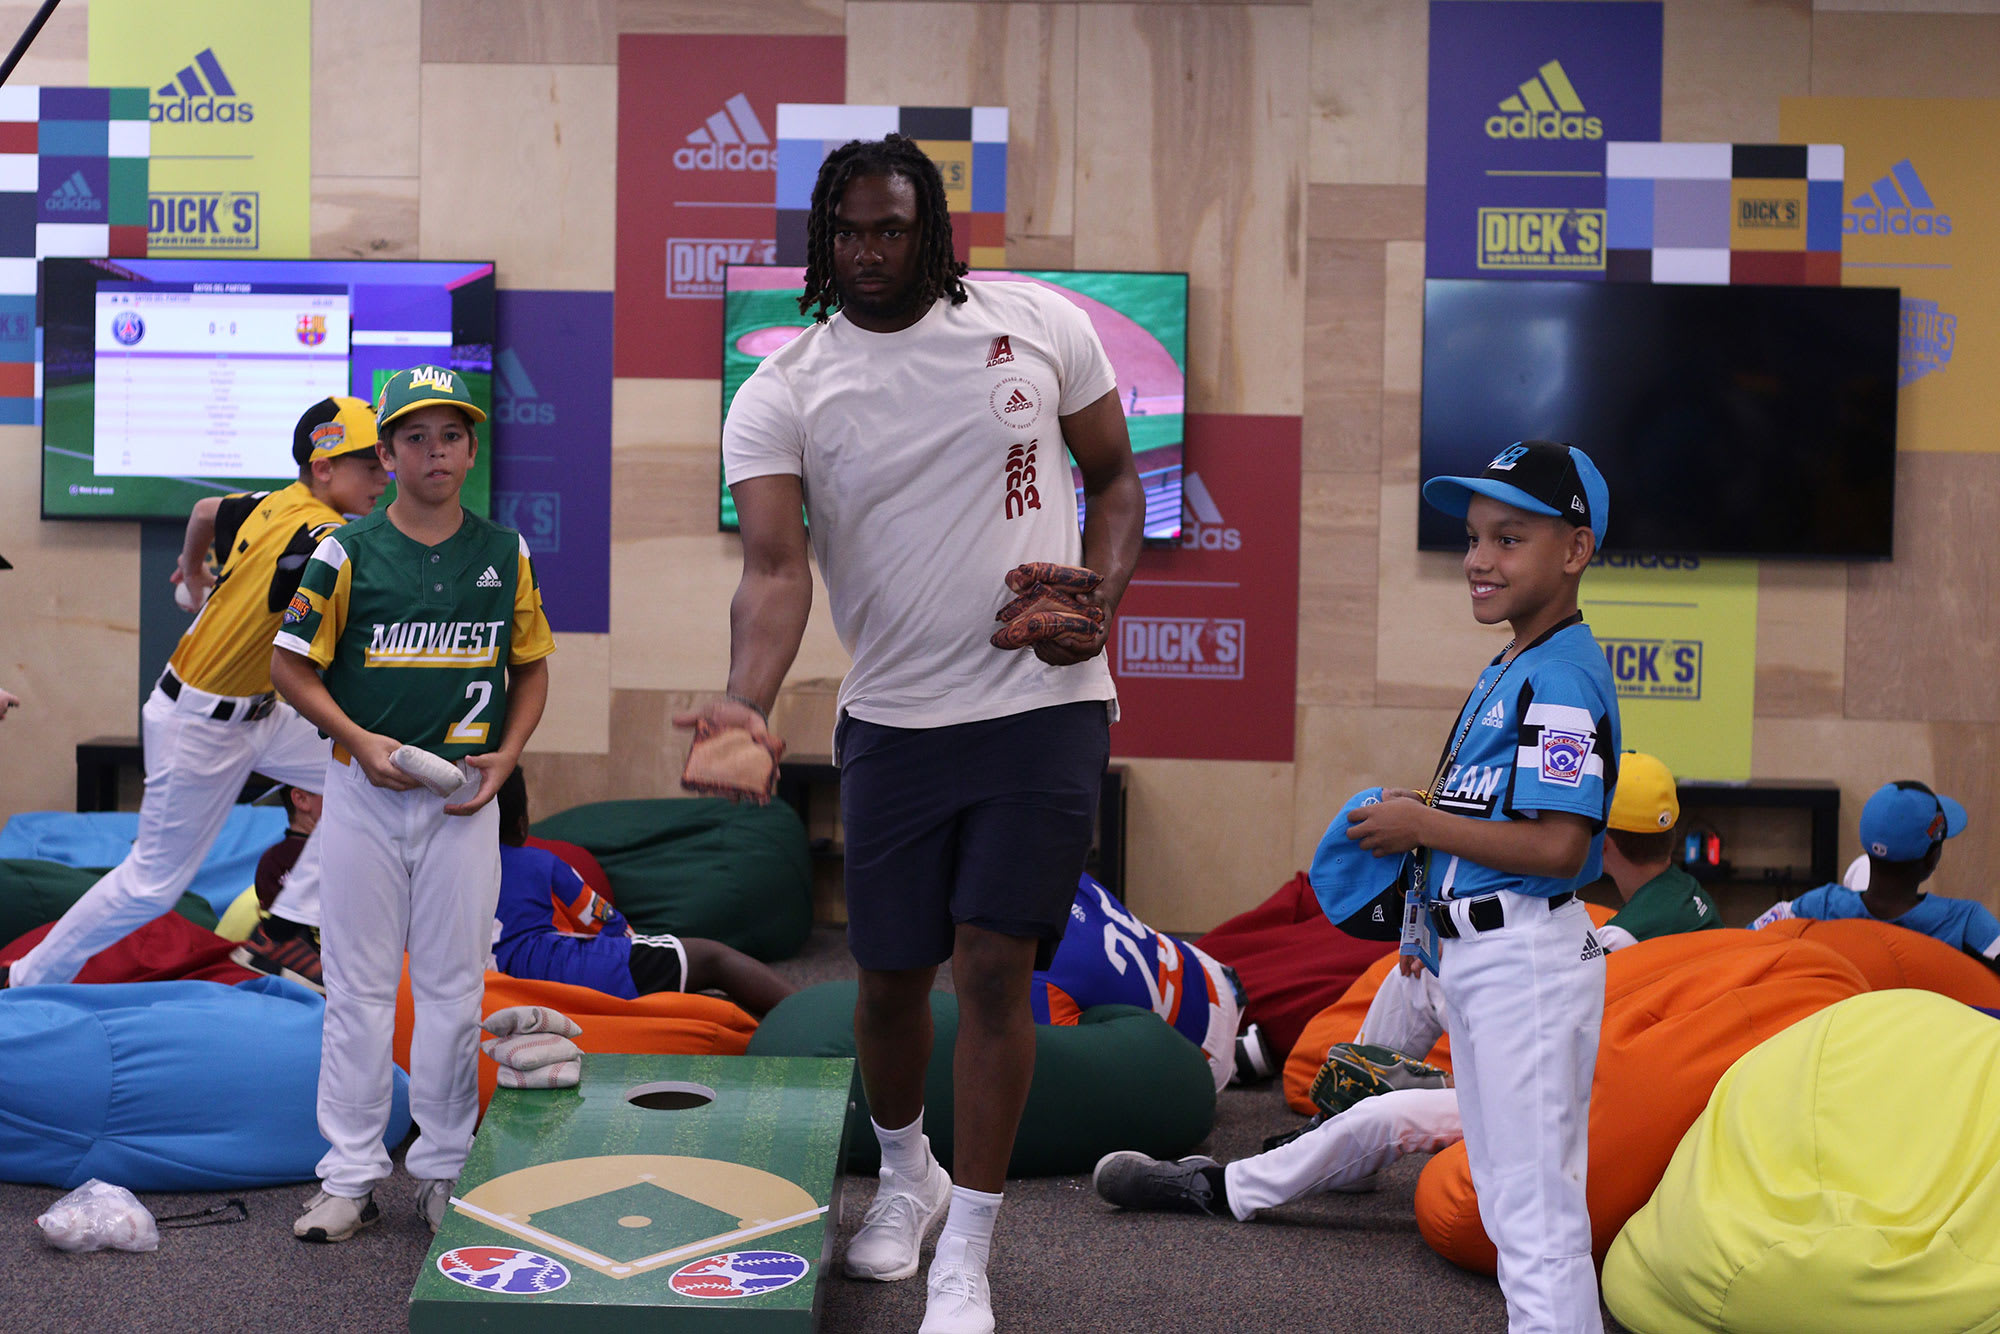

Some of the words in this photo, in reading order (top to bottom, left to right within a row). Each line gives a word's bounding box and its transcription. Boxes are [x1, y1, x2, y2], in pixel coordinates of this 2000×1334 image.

[150, 98, 254, 122] adidas
[1485, 110, 1604, 139] adidas
[45, 197, 102, 211] adidas
[1486, 214, 1600, 253] DICK'S
[1843, 207, 1952, 236] adidas
[985, 354, 1015, 368] ADIDAS
[410, 366, 453, 390] MW
[1004, 400, 1034, 414] adidas
[476, 574, 502, 588] adidas
[369, 620, 505, 661] MIDWEST
[1125, 622, 1238, 662] DICK'S
[452, 680, 493, 738] 2
